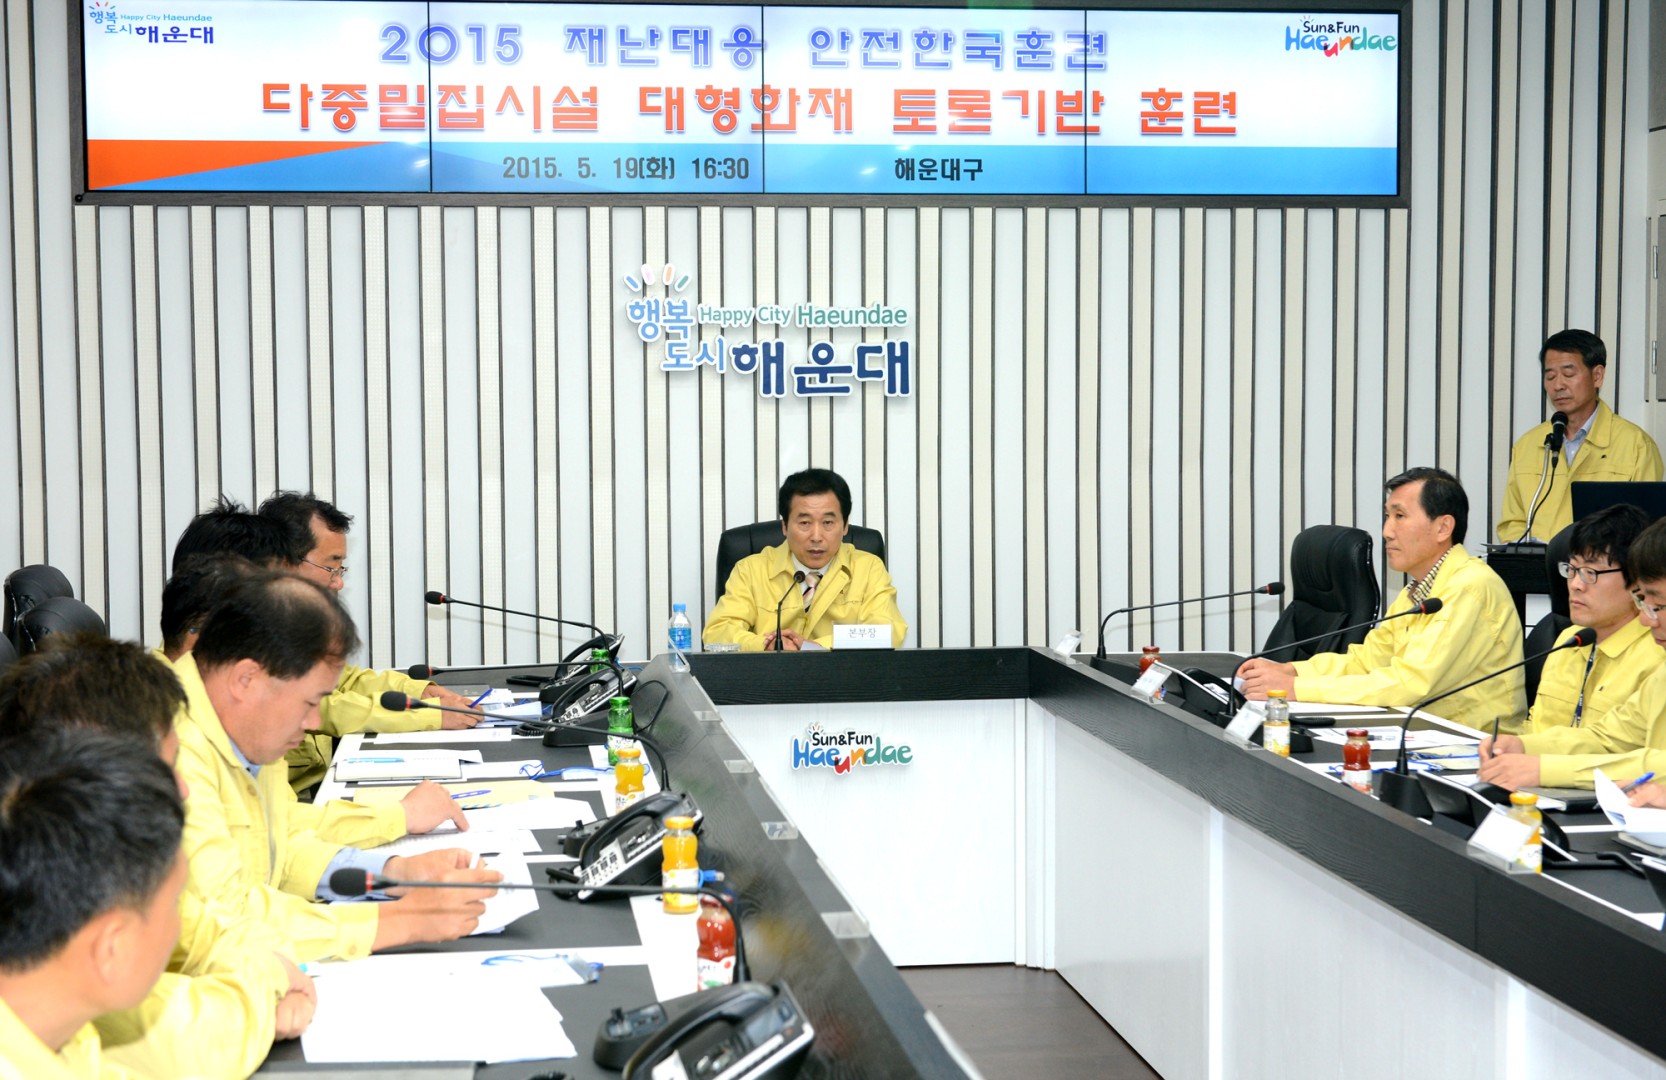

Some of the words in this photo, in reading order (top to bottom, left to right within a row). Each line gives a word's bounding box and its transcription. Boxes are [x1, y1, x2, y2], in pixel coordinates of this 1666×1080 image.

[89, 10, 118, 24] 행복
[104, 24, 132, 34] 도시
[163, 14, 213, 22] Haeundae
[1303, 21, 1360, 34] Sun&Fun
[135, 26, 214, 44] 해운대
[379, 23, 523, 64] 2015
[565, 26, 764, 68] 재난대응
[809, 28, 1106, 70] 안전한국훈련
[1285, 25, 1397, 57] Haeundae
[262, 83, 599, 132] 다중밀집시설
[638, 84, 854, 134] 대형화재
[892, 88, 1105, 135] 토론기반
[1140, 88, 1237, 135] 훈련
[502, 156, 563, 179] 2015.
[577, 157, 597, 179] 5.
[613, 156, 675, 180] 19(화)
[691, 157, 750, 180] 16:30
[894, 157, 984, 182] 해운대구
[628, 298, 694, 340] 행복
[700, 306, 752, 325] Happy
[758, 306, 790, 325] City
[797, 303, 908, 325] Haeundae
[662, 337, 725, 370] 도시
[732, 341, 910, 396] 해운대
[848, 627, 876, 639] 본부장
[811, 731, 873, 746] Sun&Fun
[793, 736, 913, 775] Haeundae
